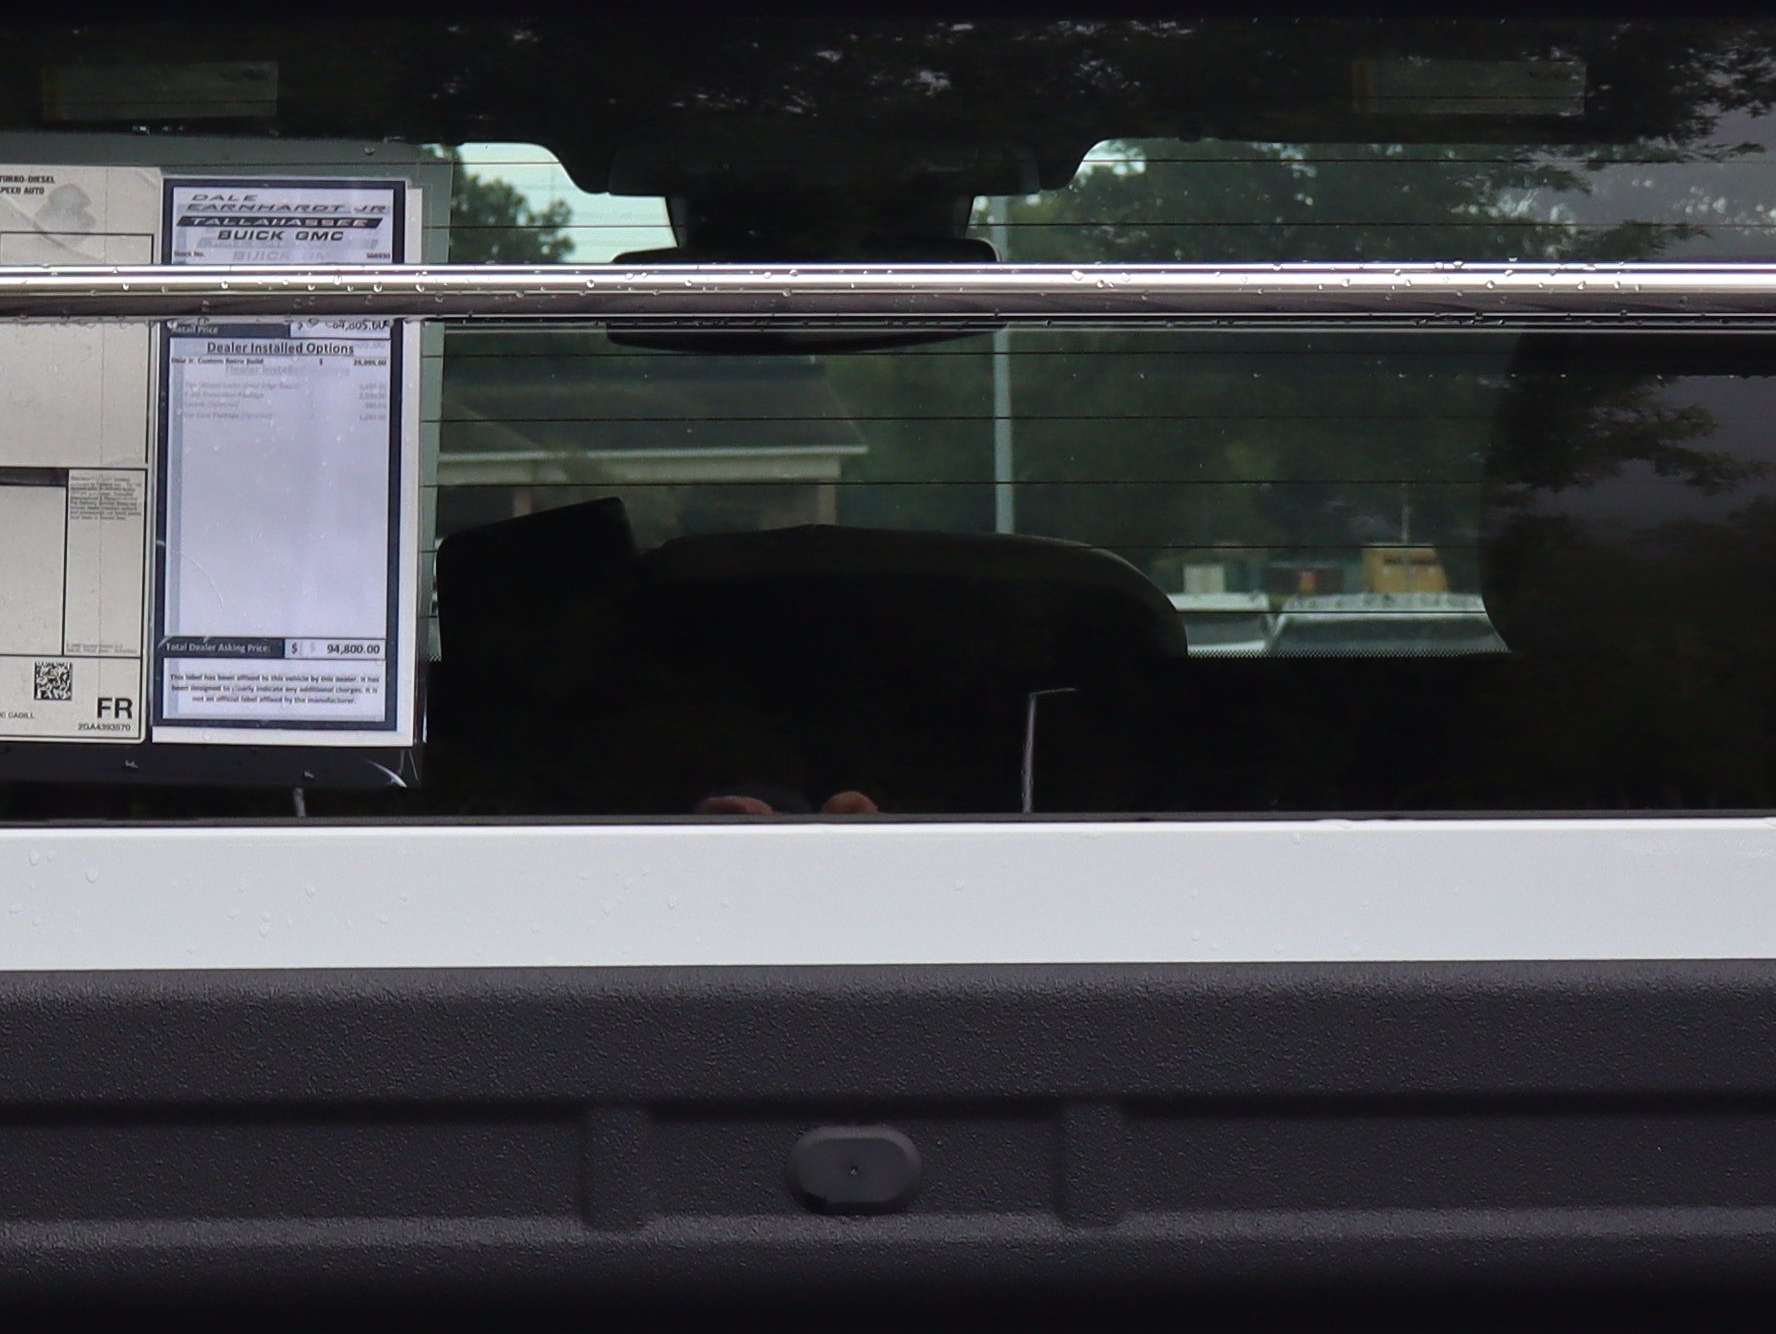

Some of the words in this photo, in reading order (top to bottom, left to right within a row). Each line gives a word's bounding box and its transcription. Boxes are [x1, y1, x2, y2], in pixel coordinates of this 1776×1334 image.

[25, 186, 45, 195] AUTO
[191, 194, 258, 202] DALE
[186, 203, 347, 213] EARNHARDT
[354, 204, 387, 213] JR
[190, 217, 369, 227] TALLAHASSEE
[218, 230, 286, 241] BUICK
[295, 231, 344, 242] GMC
[207, 342, 248, 355] Dealer
[251, 343, 303, 355] Installed
[306, 343, 354, 356] Options
[166, 642, 188, 652] Total
[190, 643, 216, 653] Dealer
[218, 643, 246, 653] Asking
[247, 643, 271, 654] Price:
[291, 643, 298, 654] $
[326, 644, 381, 655] 94,800.00
[97, 698, 133, 719] FR
